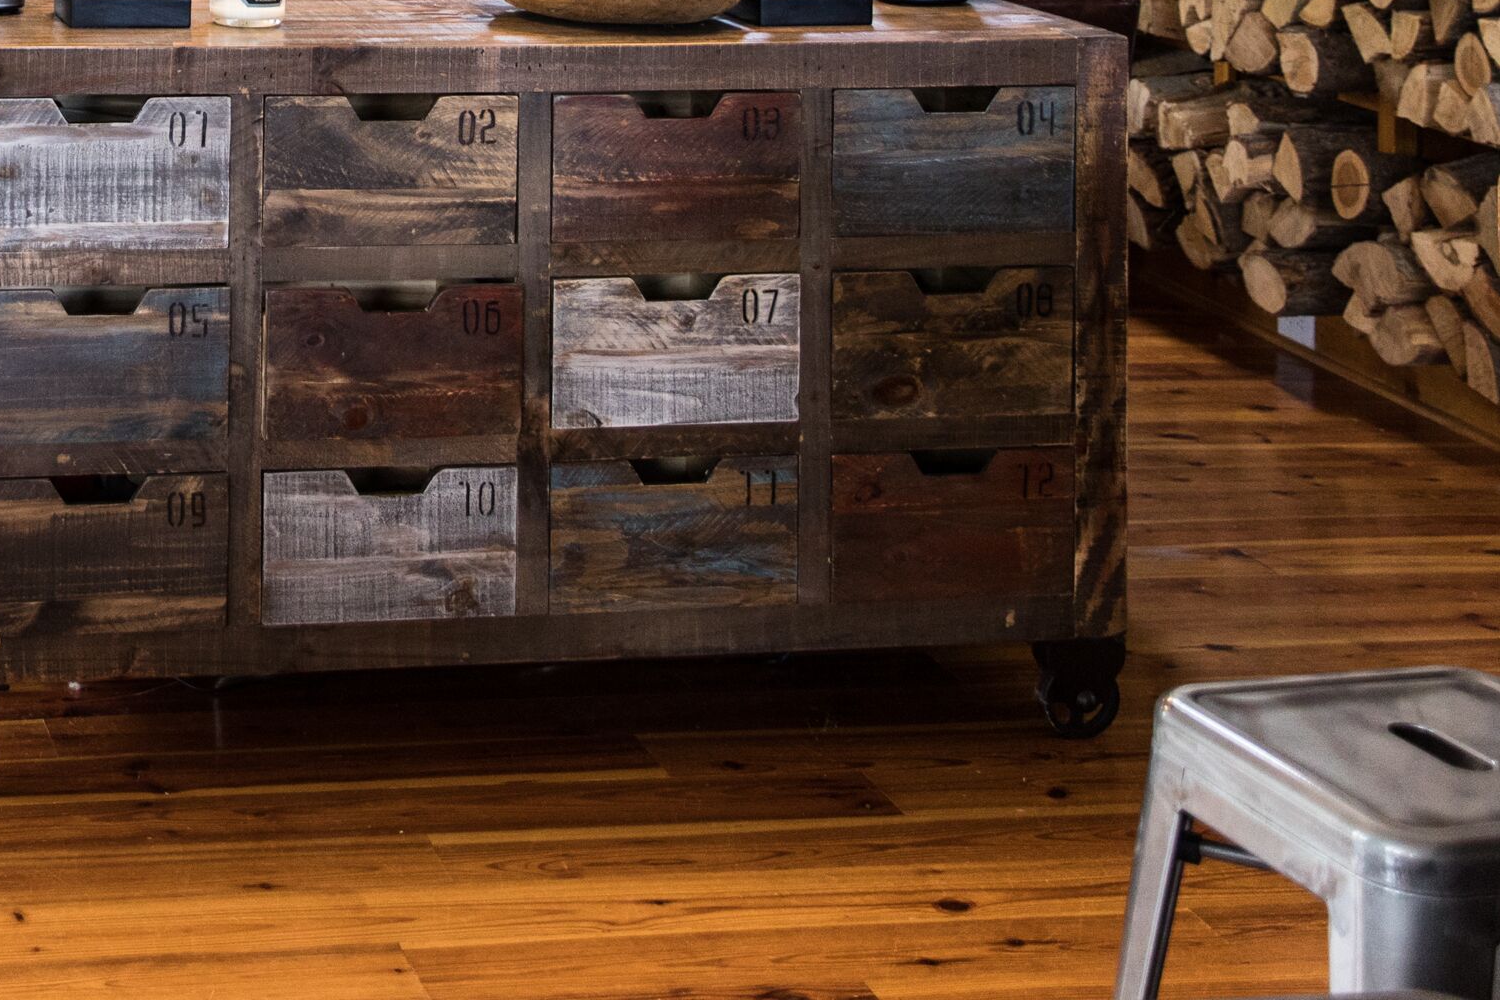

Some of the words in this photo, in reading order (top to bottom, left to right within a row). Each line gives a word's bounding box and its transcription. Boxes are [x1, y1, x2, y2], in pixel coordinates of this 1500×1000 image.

[168, 110, 208, 148] 01
[457, 109, 497, 146] 02
[741, 106, 781, 142] 03
[1016, 100, 1056, 137] 04
[462, 299, 501, 335] 06
[741, 288, 779, 325] 07
[1016, 282, 1054, 319] 08
[168, 301, 209, 338] 05
[458, 480, 496, 517] 10
[739, 469, 776, 506] 11
[1018, 462, 1055, 499] 12
[167, 491, 207, 528] 09
